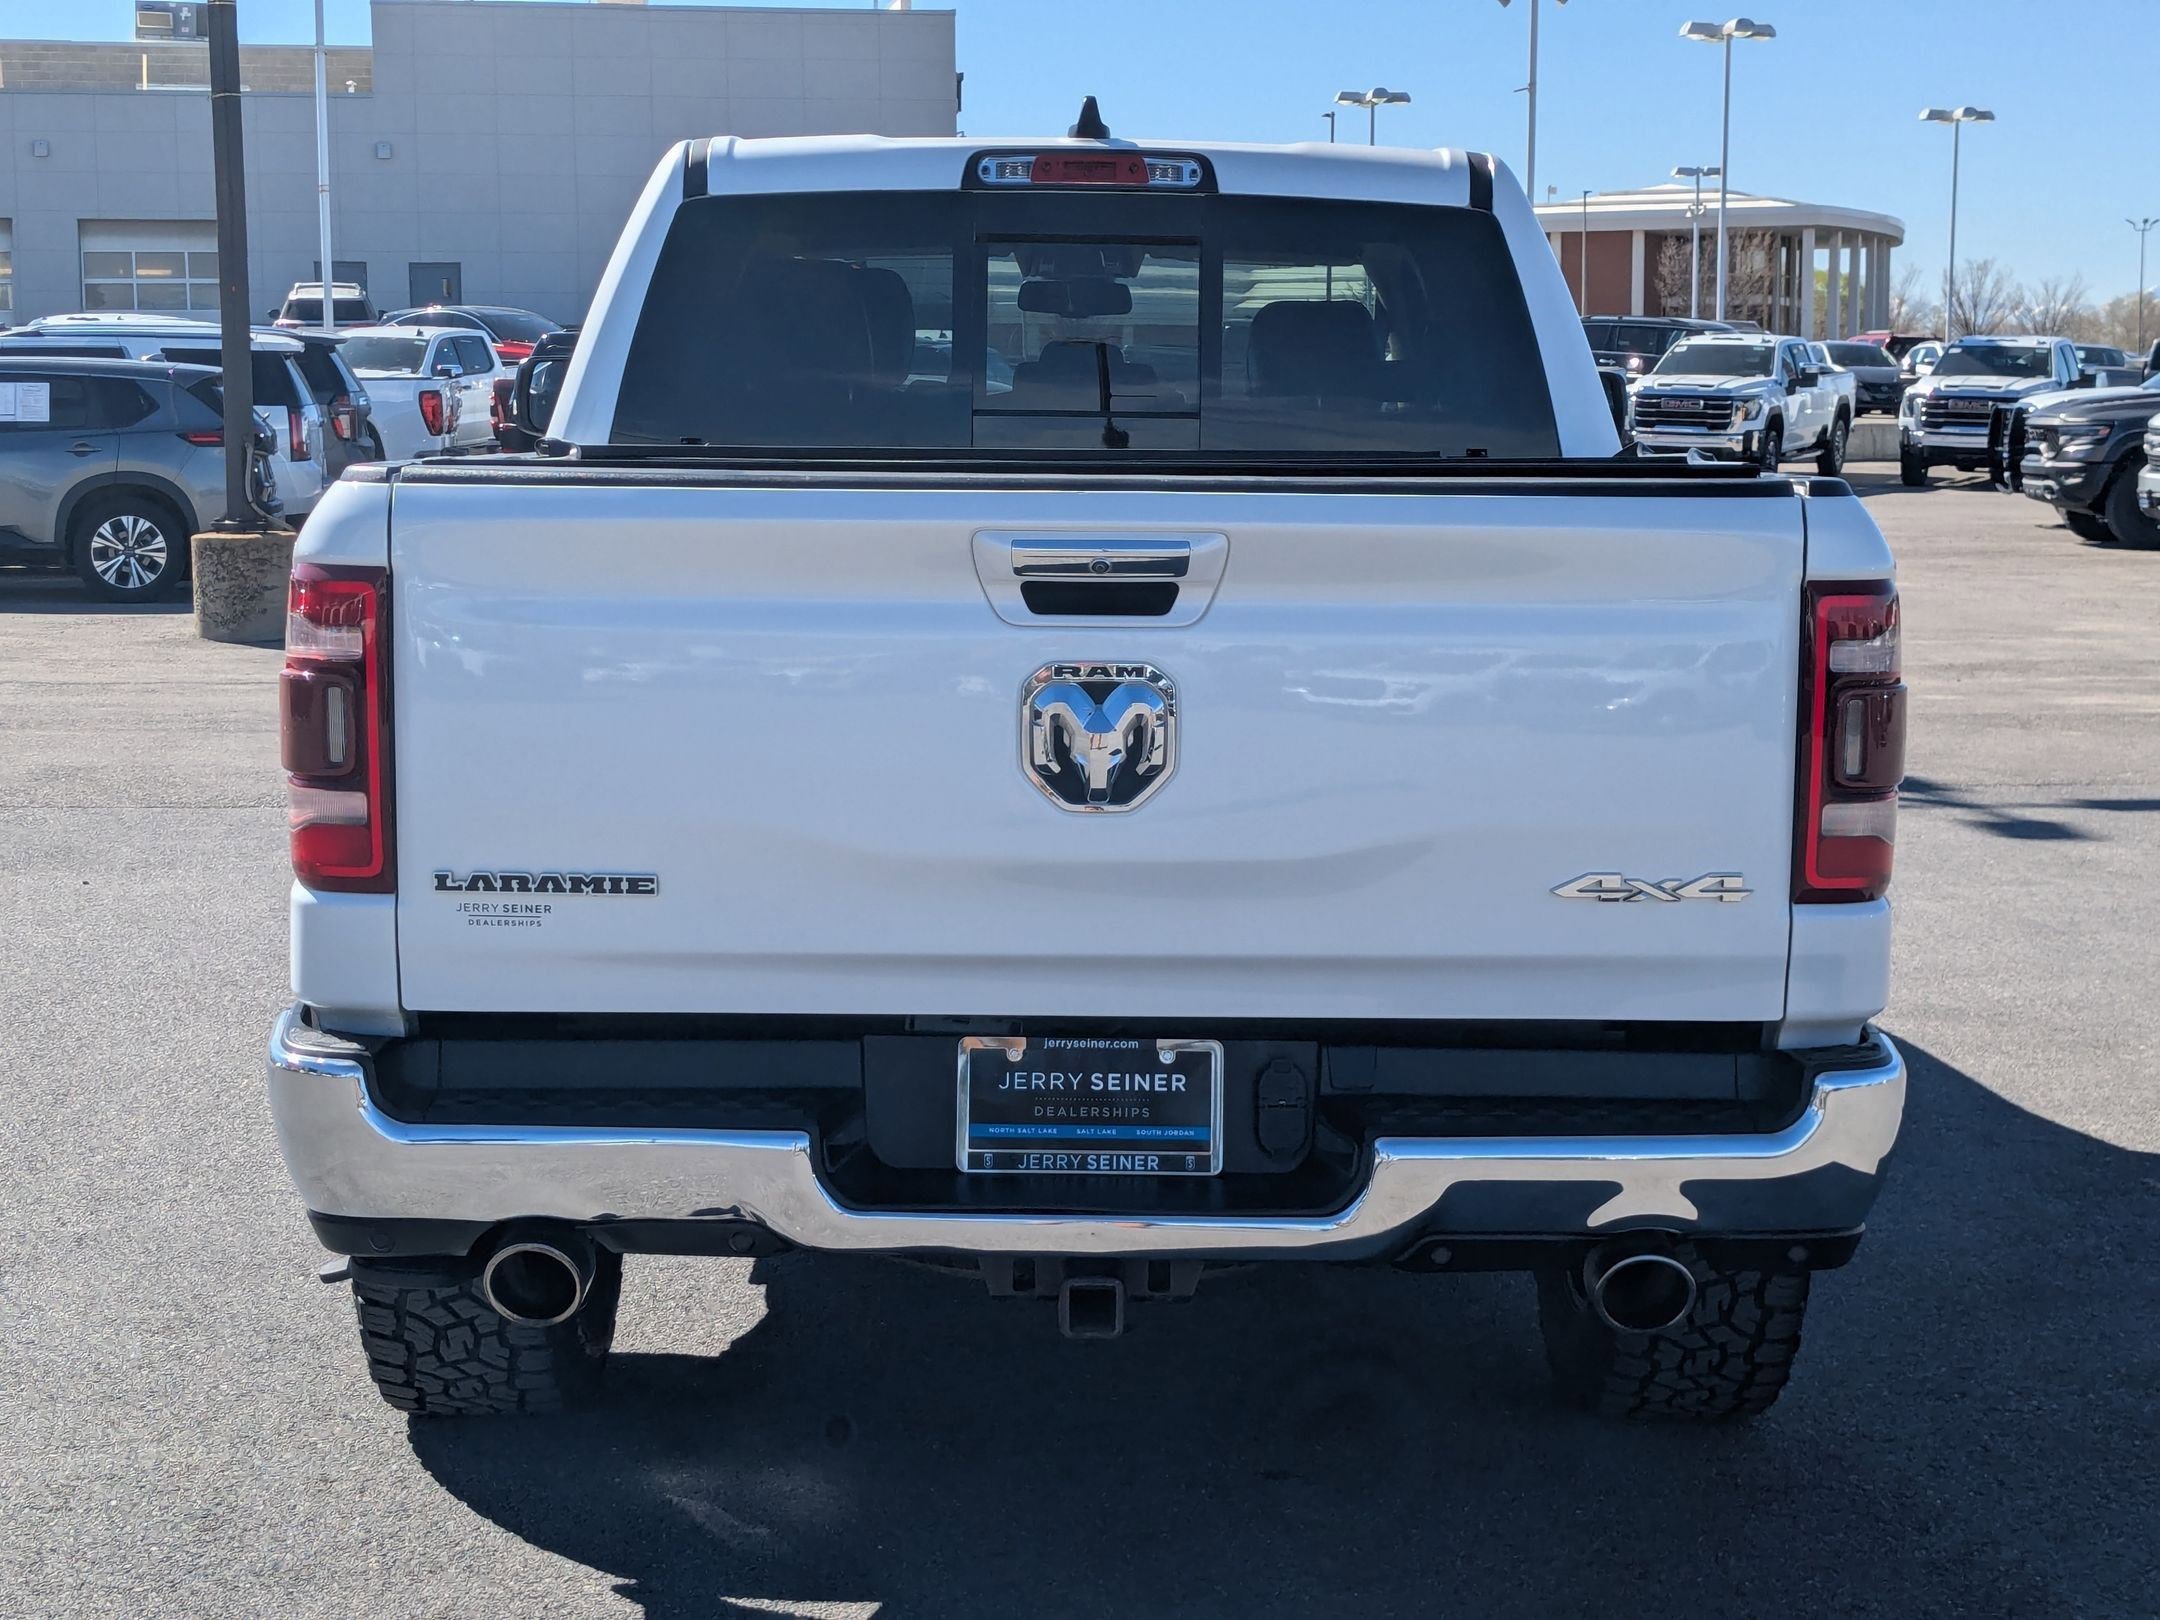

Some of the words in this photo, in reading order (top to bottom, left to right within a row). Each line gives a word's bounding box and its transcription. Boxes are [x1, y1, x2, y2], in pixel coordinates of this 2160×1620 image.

[1052, 665, 1146, 680] RAM
[432, 871, 659, 897] LARAMIE
[456, 902, 499, 913] JERRY
[502, 903, 552, 914] SEINER
[468, 918, 542, 927] DEALERSHIPS
[1043, 1038, 1139, 1050] jerryseiner.com
[998, 1072, 1083, 1090] JERRY
[1090, 1073, 1187, 1092] SEINER
[1034, 1105, 1151, 1118] DEALERSHIPS
[1018, 1154, 1082, 1169] JERRY
[1087, 1155, 1159, 1170] SEINER
